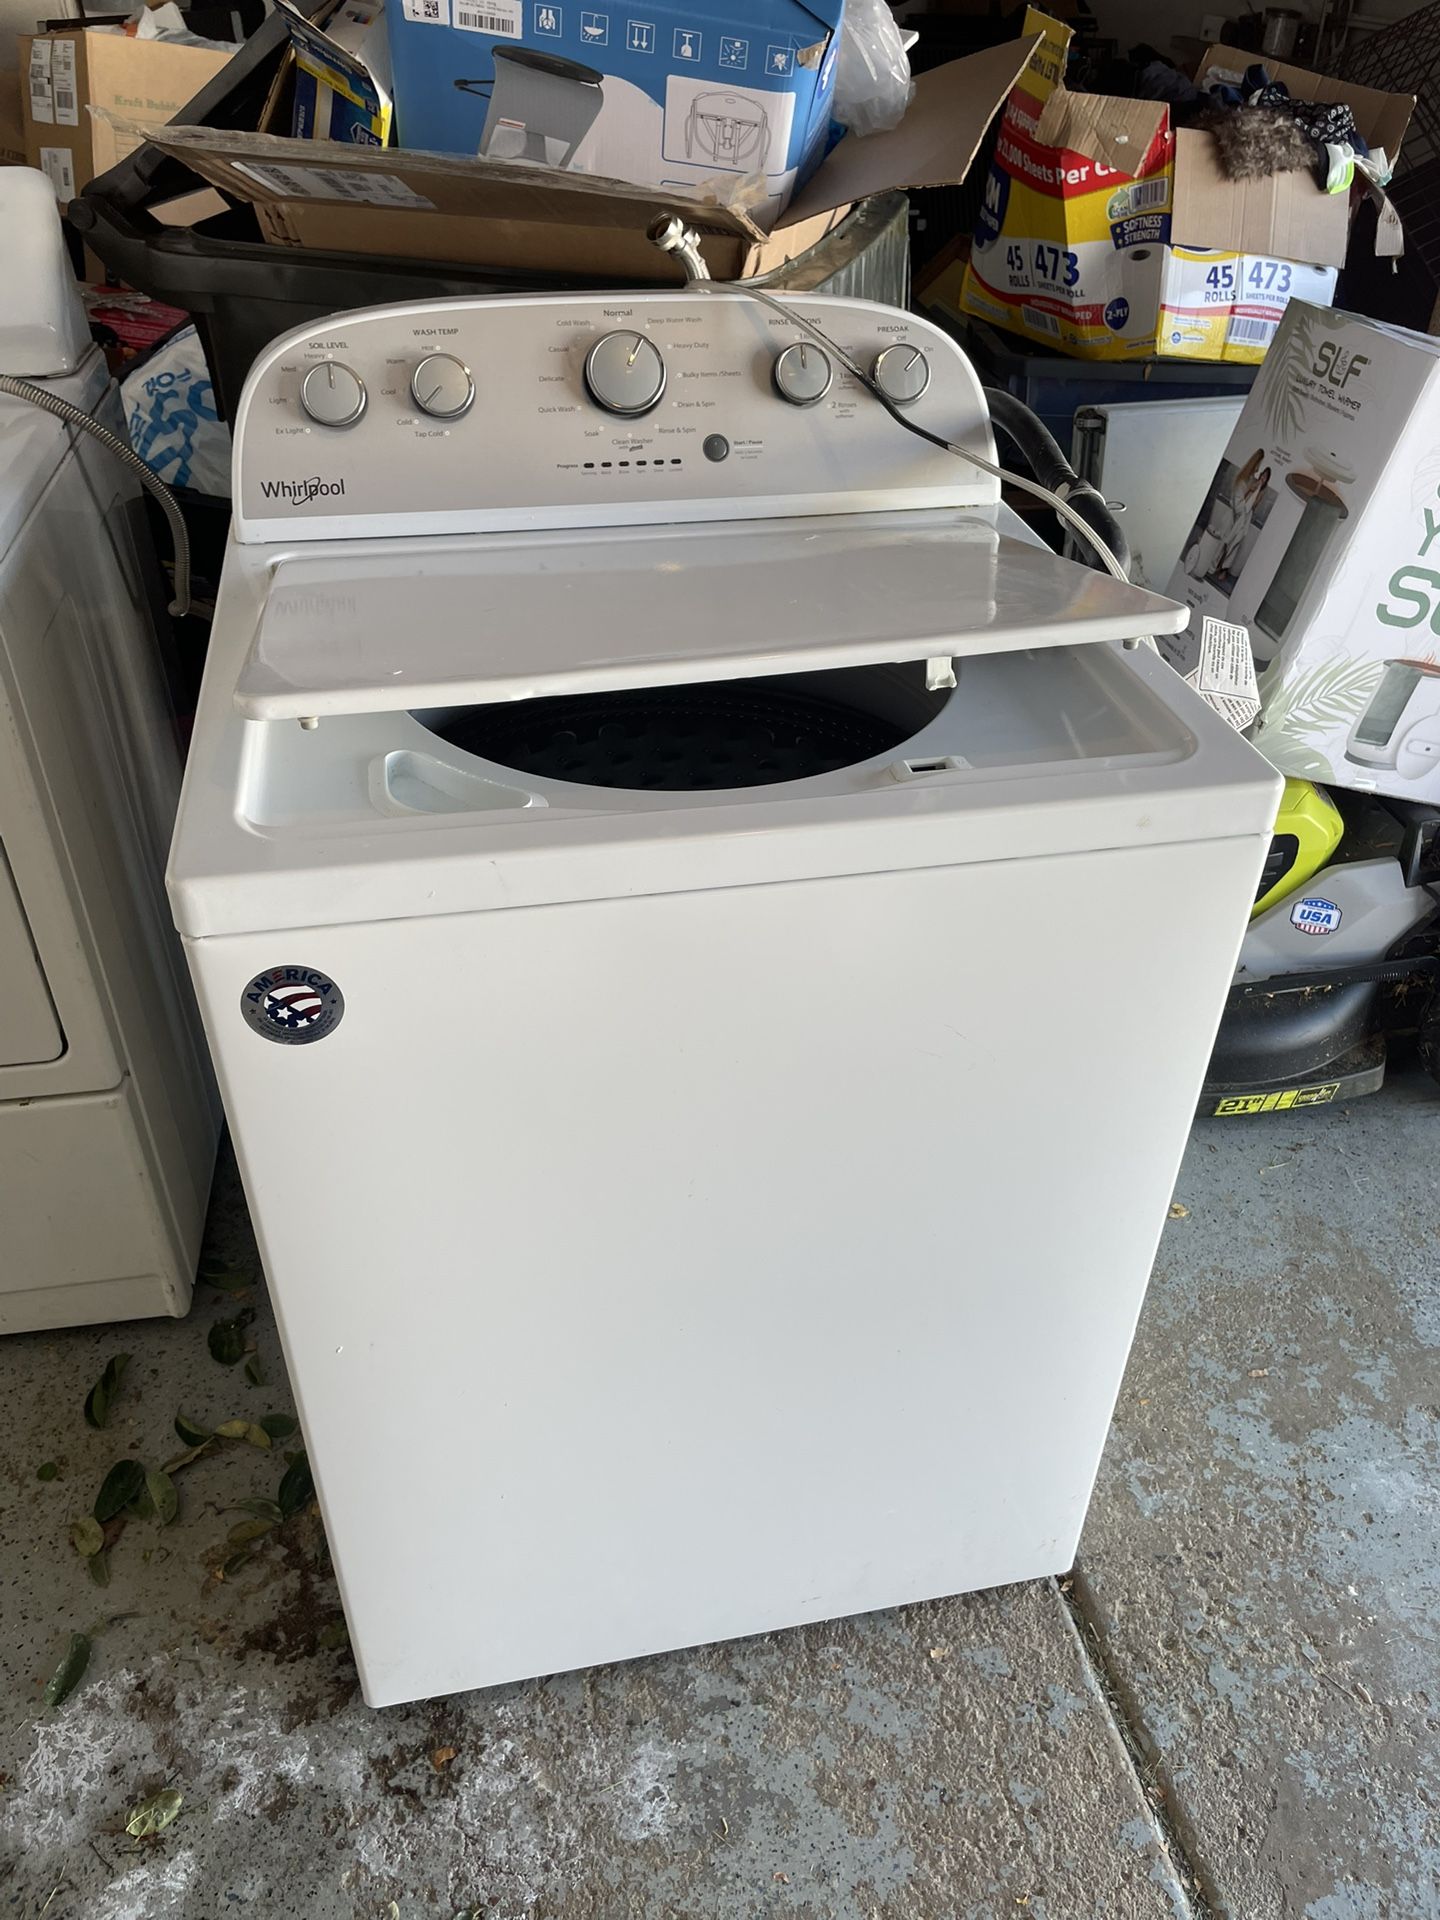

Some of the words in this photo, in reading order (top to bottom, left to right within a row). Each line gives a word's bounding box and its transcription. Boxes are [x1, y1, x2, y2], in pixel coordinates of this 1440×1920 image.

[1024, 151, 1054, 184] Sheets
[1056, 164, 1090, 185] Per
[1123, 216, 1163, 233] SOFTNESS
[1124, 229, 1161, 244] STRENGTH
[1007, 246, 1023, 271] 45
[1035, 245, 1080, 286] 473
[1009, 275, 1030, 288] ROLLS
[1206, 265, 1234, 288] 45
[1249, 262, 1292, 293] 473
[1204, 290, 1237, 303] ROLLS
[1246, 292, 1265, 300] SHEETS
[603, 309, 632, 317] Normal
[438, 328, 459, 336] TEMP
[309, 342, 325, 350] SOIL
[673, 342, 692, 350] Heavy
[286, 427, 303, 435] Light
[260, 477, 345, 505] Whirlpool
[1300, 909, 1332, 925] USA
[246, 968, 333, 1004] AMERICA
